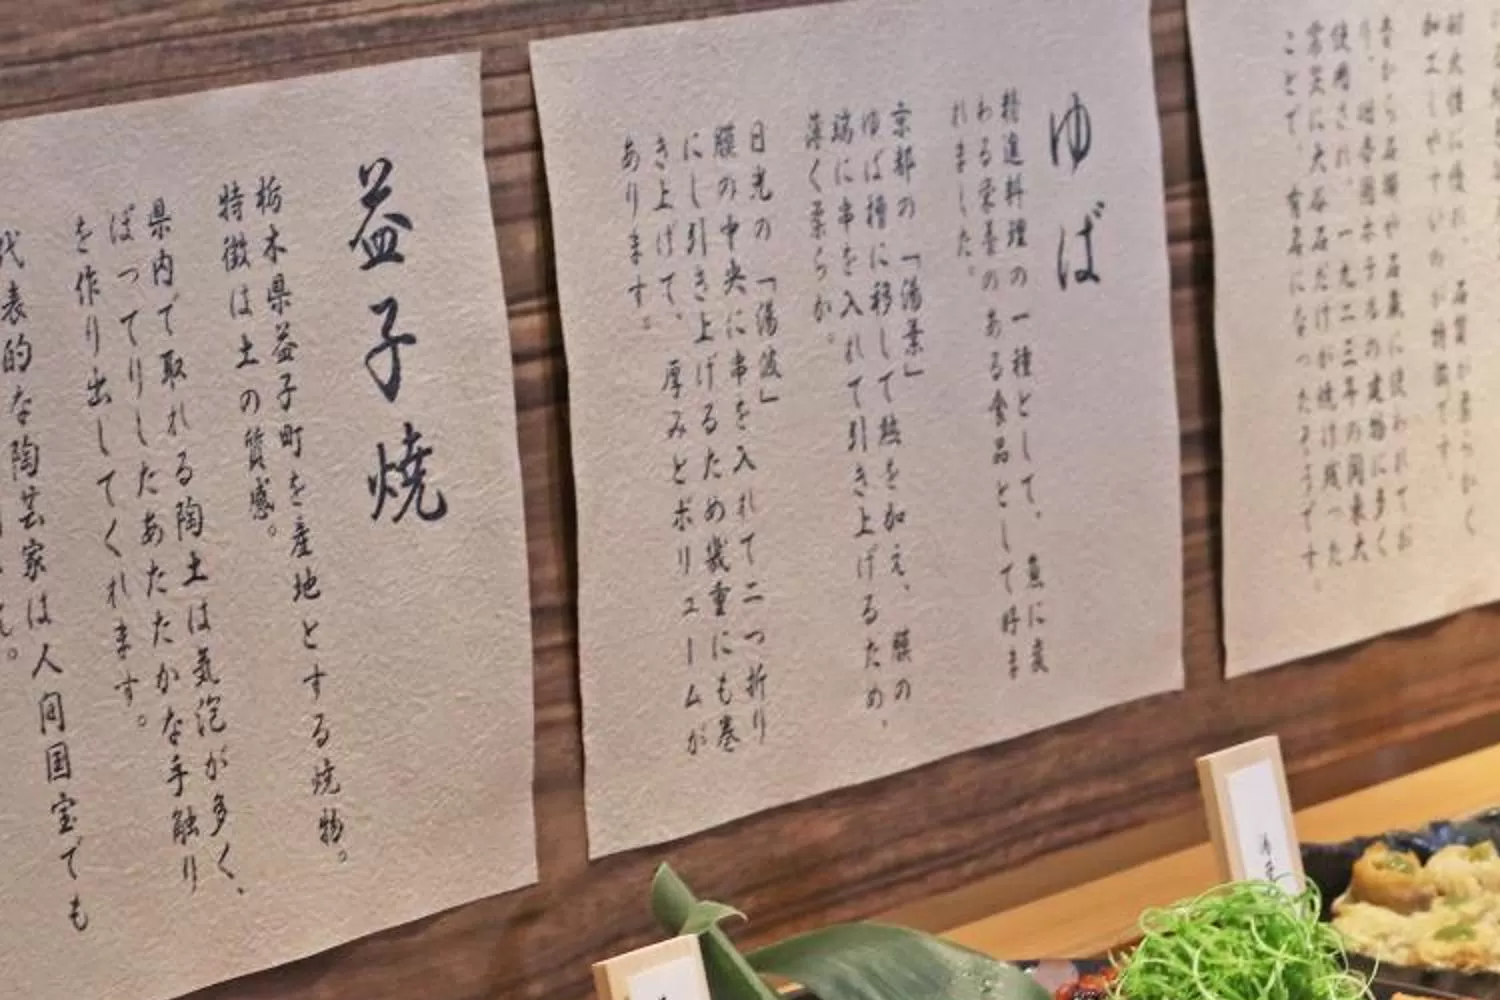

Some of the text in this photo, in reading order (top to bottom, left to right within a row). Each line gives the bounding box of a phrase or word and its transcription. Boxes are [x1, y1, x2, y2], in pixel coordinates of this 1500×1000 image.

[1049, 91, 1105, 291] ゆば
[350, 157, 448, 524] 益子焼
